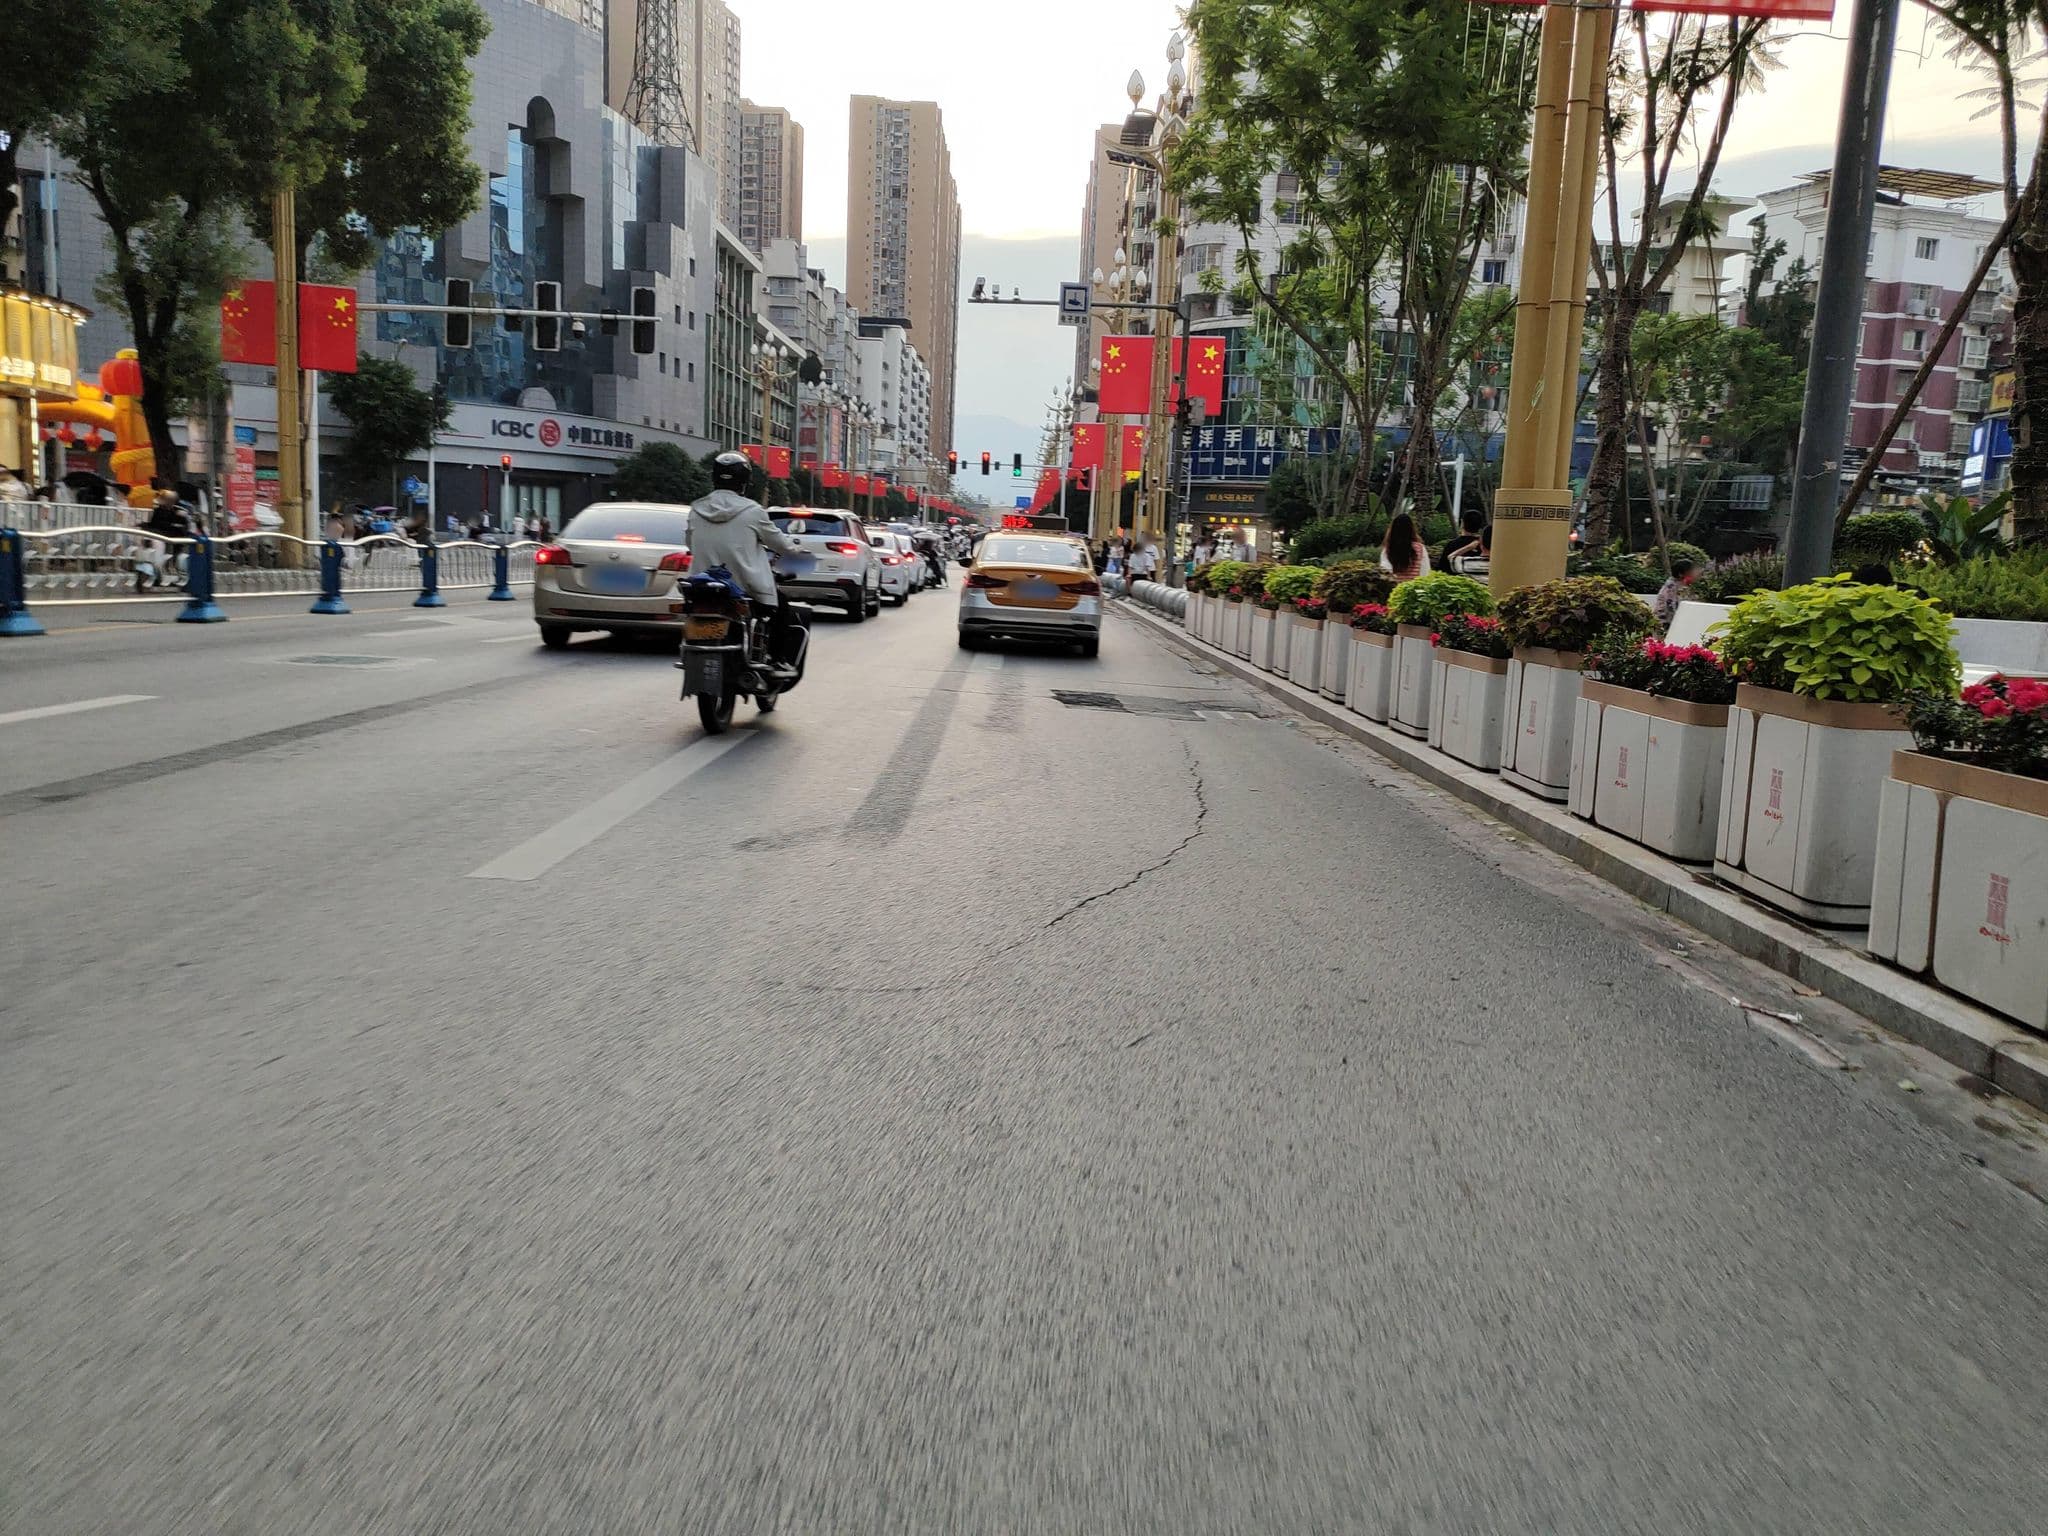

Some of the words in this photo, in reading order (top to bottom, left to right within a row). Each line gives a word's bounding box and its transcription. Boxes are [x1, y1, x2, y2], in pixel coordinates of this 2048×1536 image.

[491, 419, 535, 439] ICBC
[567, 424, 634, 449] 中国工商银行
